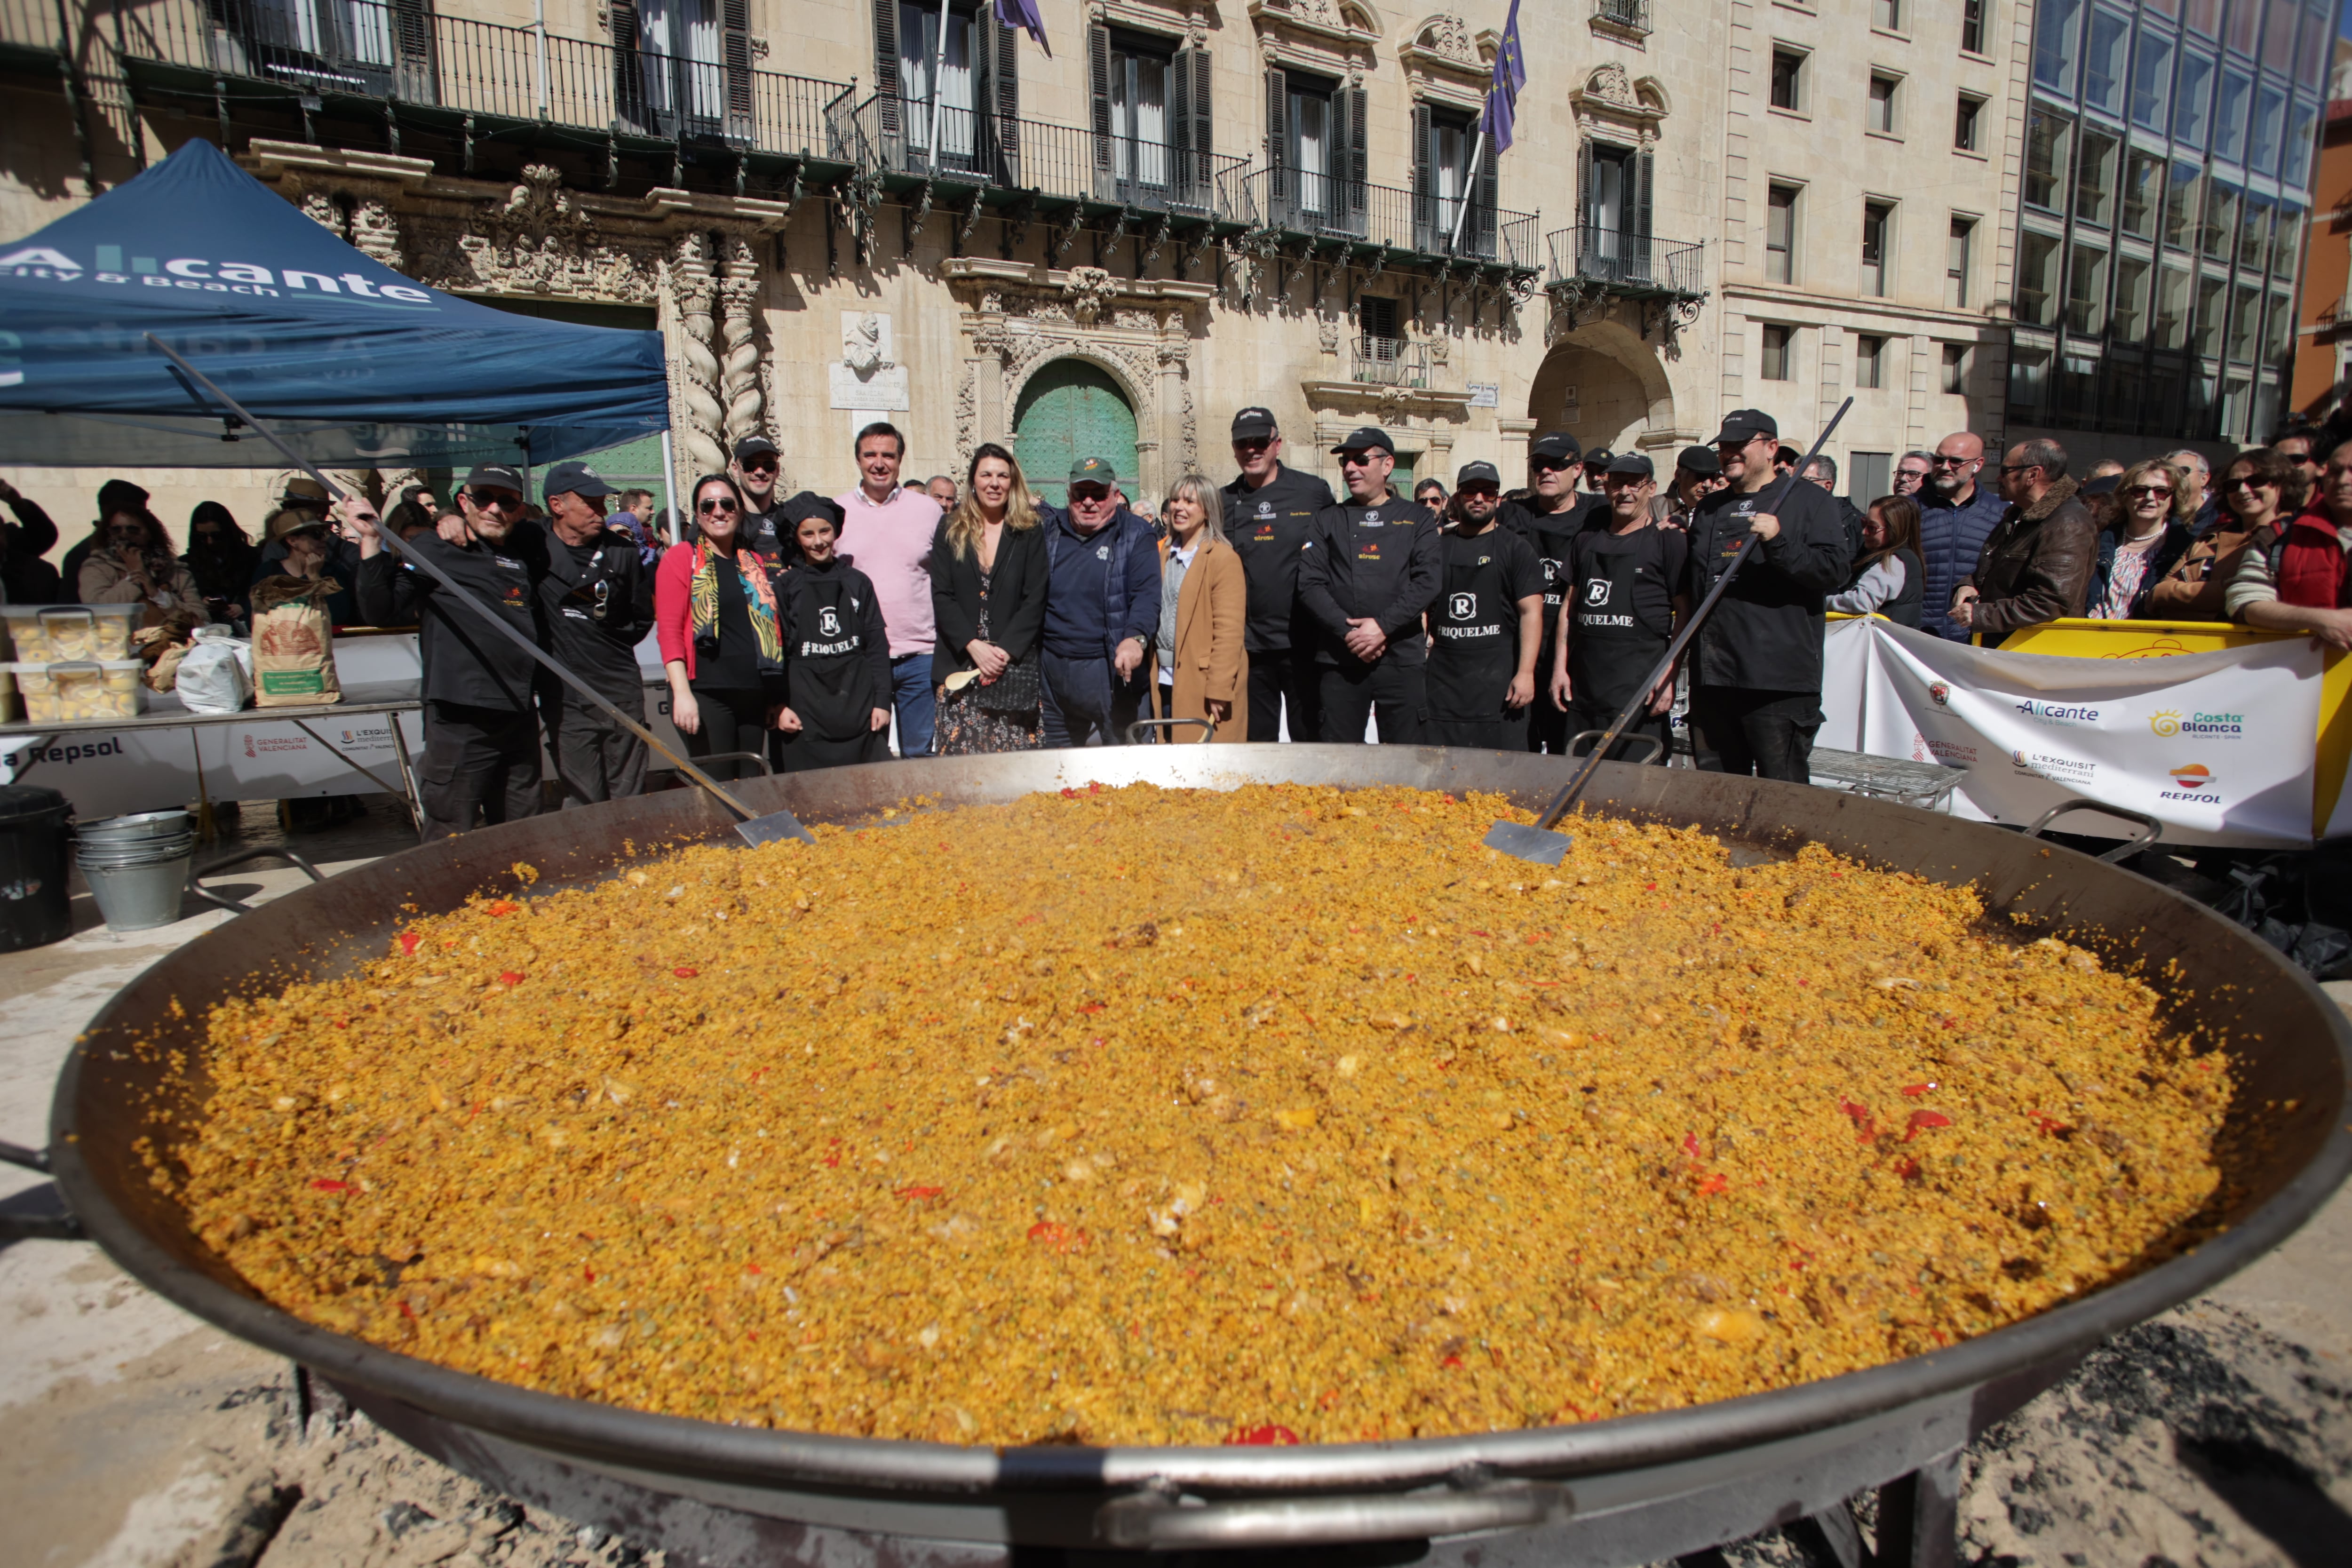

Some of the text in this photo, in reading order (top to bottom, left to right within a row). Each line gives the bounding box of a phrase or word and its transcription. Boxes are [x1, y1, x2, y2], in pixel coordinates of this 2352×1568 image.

[95, 272, 131, 283] &
[143, 276, 280, 297] Beach
[1589, 584, 1605, 600] R
[1455, 598, 1470, 614] R
[822, 613, 837, 630] R
[2016, 700, 2099, 721] Alicante
[2193, 712, 2242, 723] Costa
[2034, 717, 2047, 725] City
[2182, 722, 2242, 733] Blanca
[28, 737, 123, 764] Repsol
[1929, 740, 1977, 755] GENERALITAT
[1931, 749, 1978, 763] VALENCIANA
[2032, 754, 2096, 771] L'EXQUISIT
[2014, 770, 2091, 786] COMUNITAT VALENCIANA
[2160, 791, 2221, 804] REPSOL
